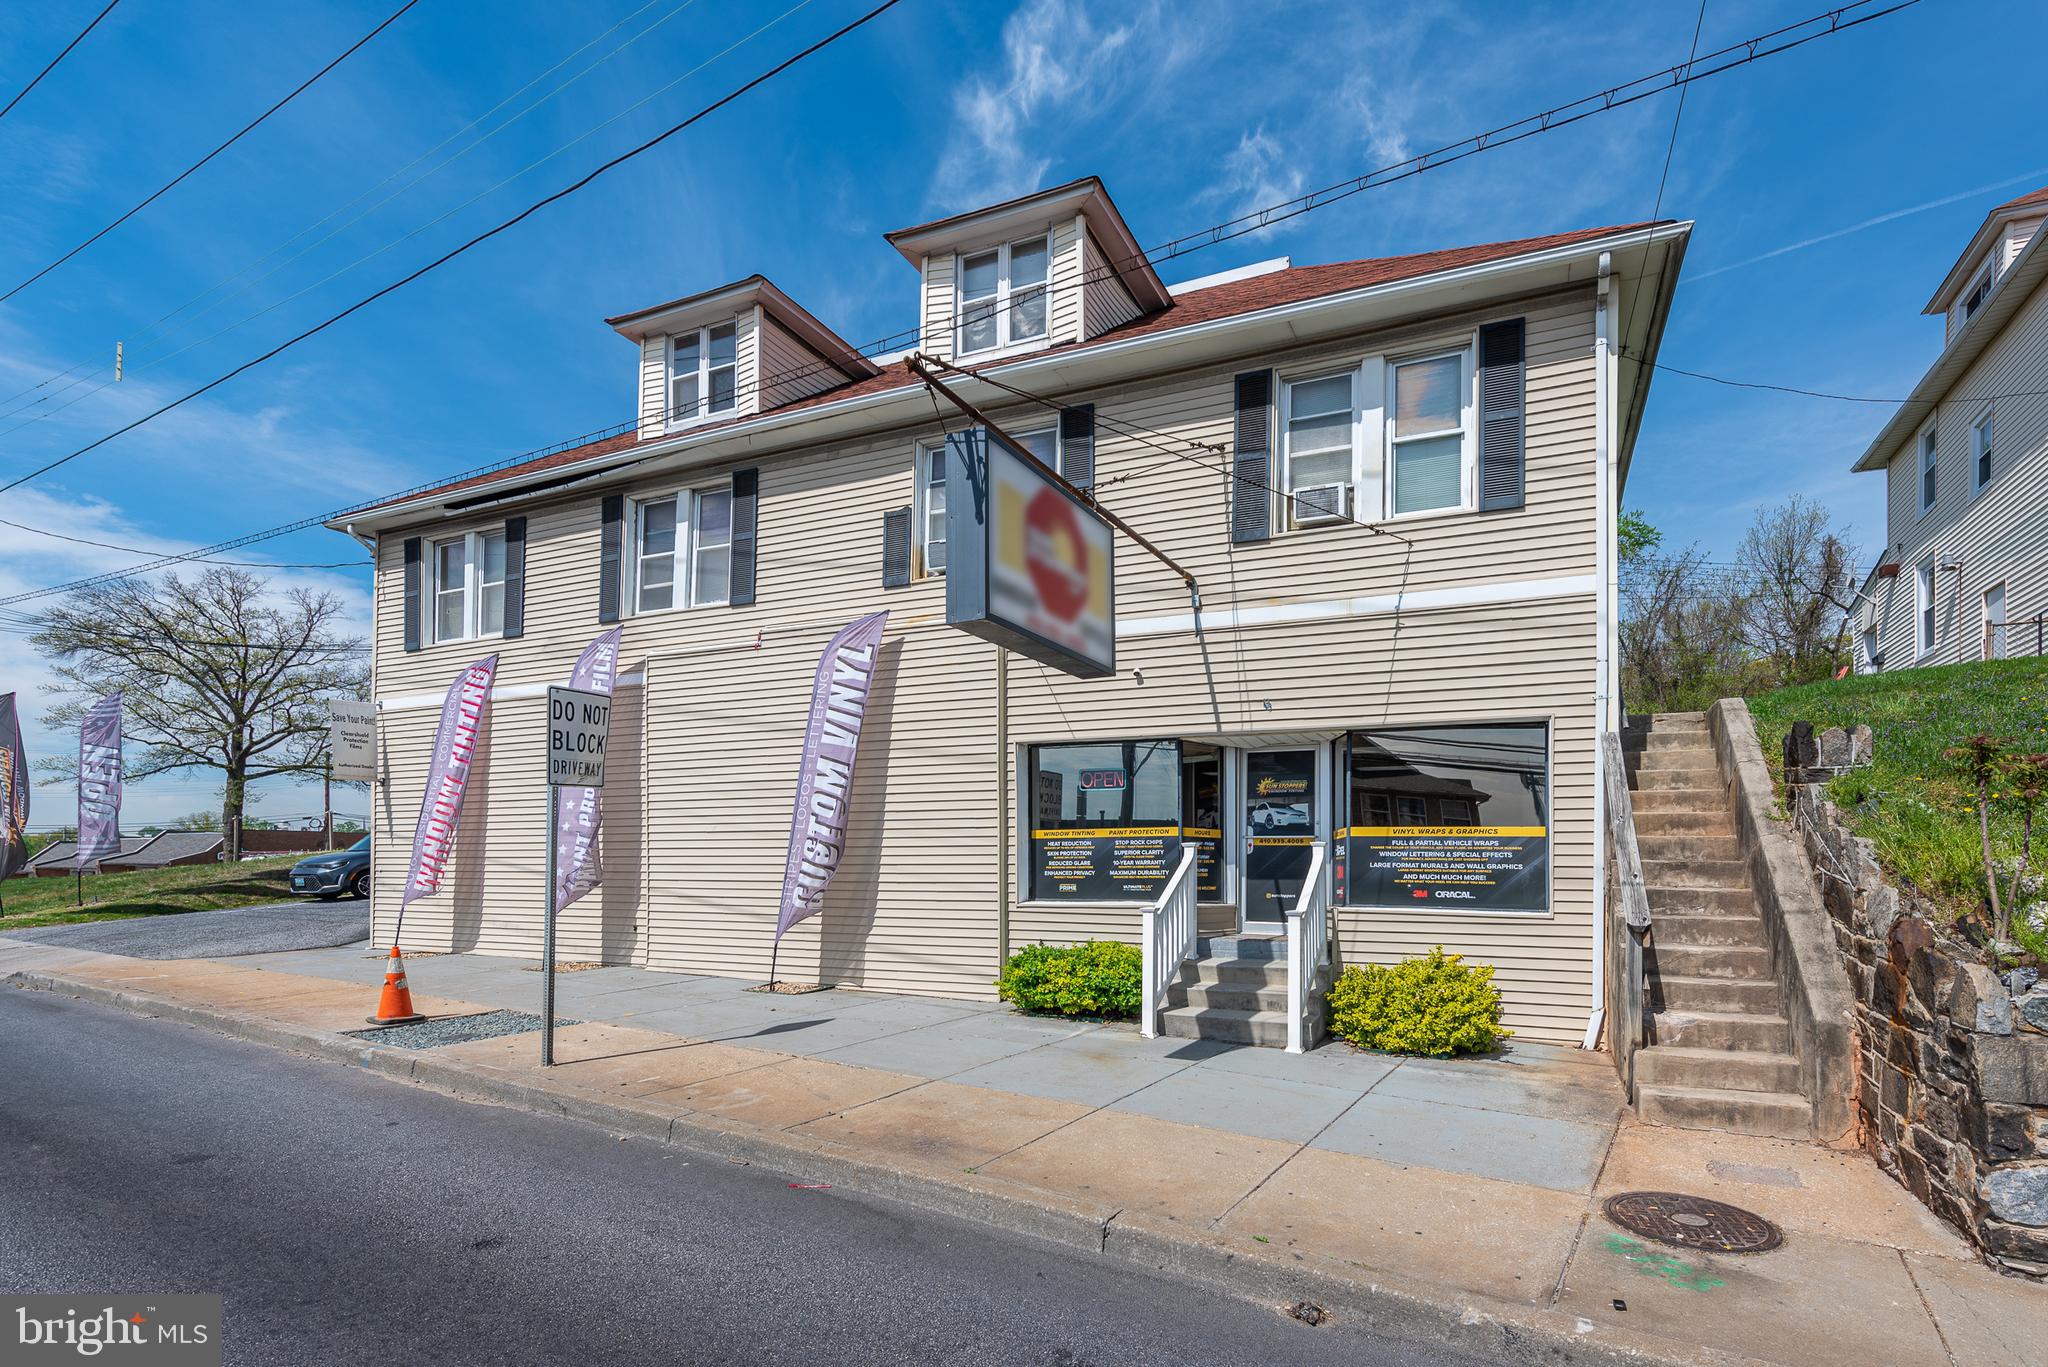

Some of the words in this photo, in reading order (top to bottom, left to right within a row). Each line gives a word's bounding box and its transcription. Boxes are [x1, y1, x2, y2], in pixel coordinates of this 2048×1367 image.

[591, 640, 614, 692] FILM
[332, 712, 346, 723] Save
[347, 713, 359, 724] Your
[553, 700, 575, 721] DO
[583, 704, 608, 726] NOT
[821, 643, 875, 750] VINYL
[415, 772, 443, 847] RESIDENTIAL
[438, 686, 461, 762] COMMERCIAL
[553, 730, 605, 755] BLOCK
[553, 760, 602, 777] DRIVEWAY
[80, 742, 121, 818] OPEN
[414, 774, 464, 892] WINDOW
[449, 666, 491, 770] TINTING
[782, 845, 800, 907] STRIPES
[796, 774, 811, 829] LOGOS
[807, 671, 829, 758] LETTERING
[1081, 772, 1124, 788] OPEN
[793, 754, 850, 909] CUSTOM
[1413, 890, 1428, 898] 3M
